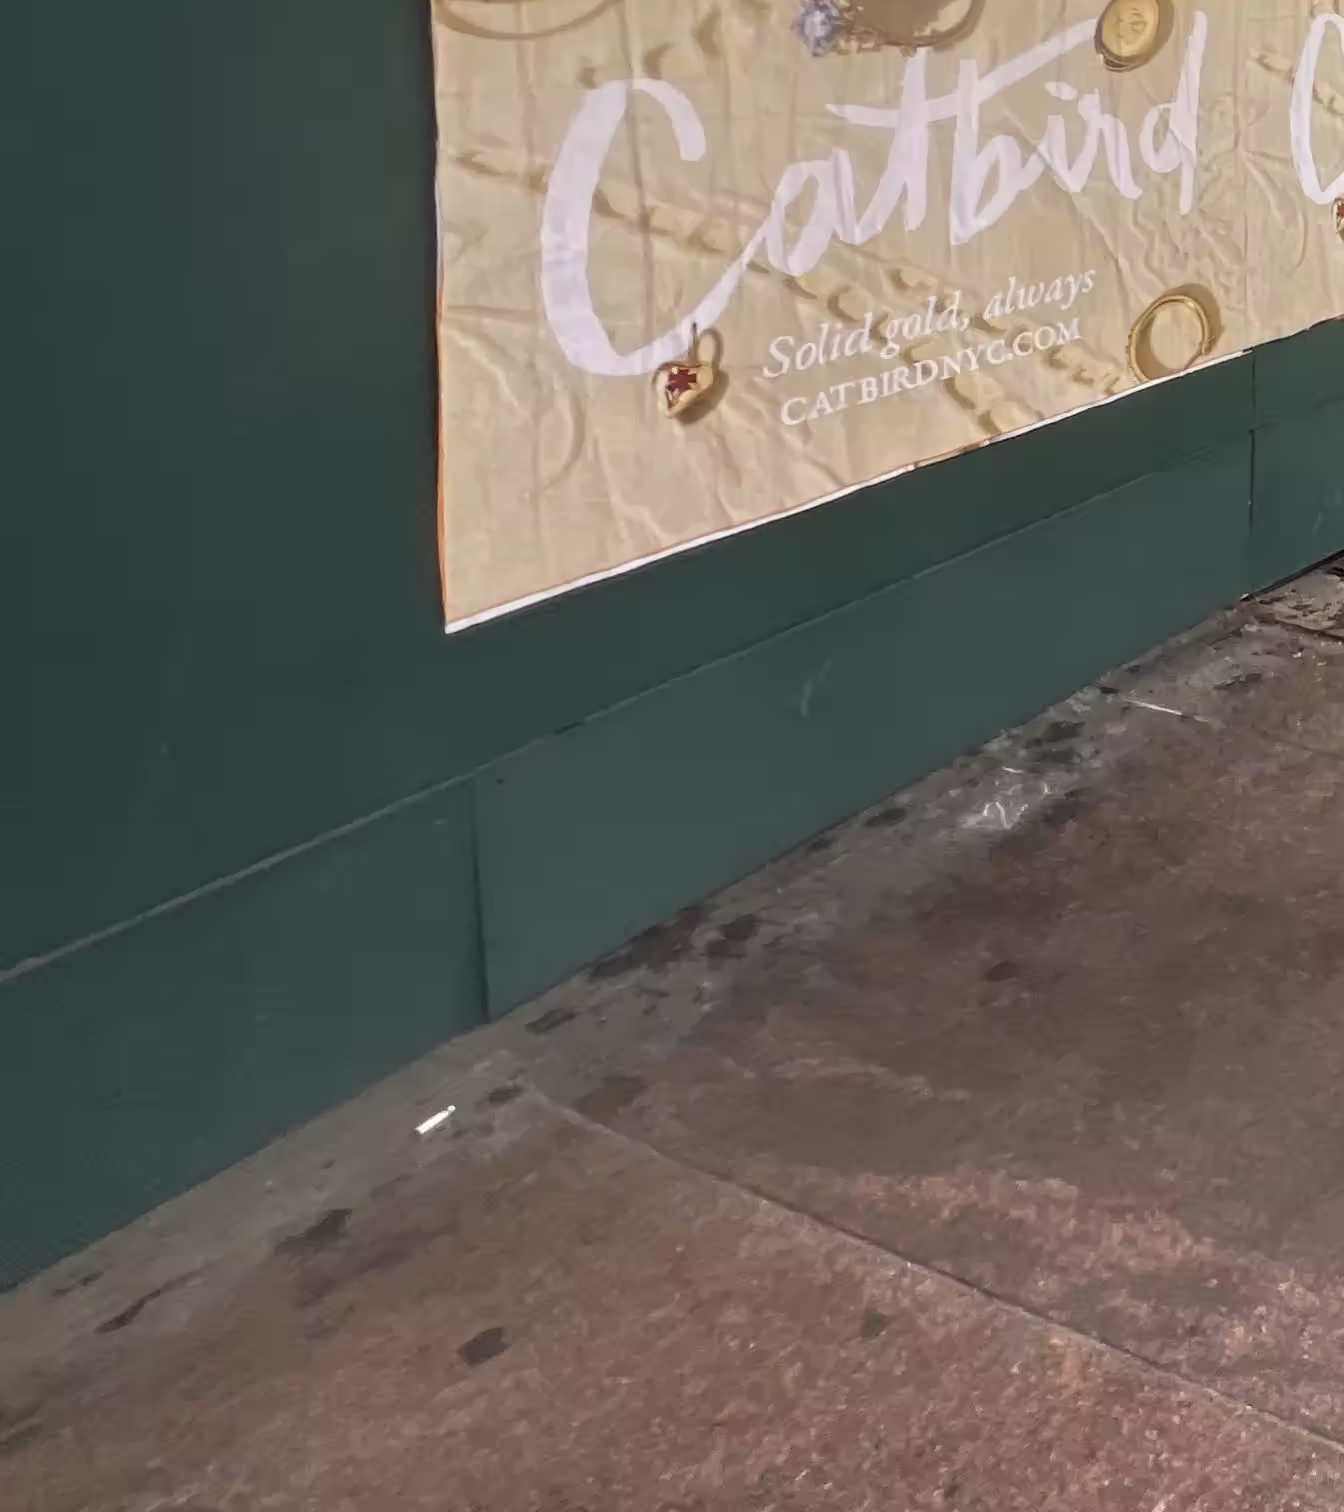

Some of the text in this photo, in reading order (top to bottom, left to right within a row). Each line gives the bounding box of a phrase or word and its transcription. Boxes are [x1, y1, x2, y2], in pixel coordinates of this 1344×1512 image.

[541, 11, 1208, 377] Catbird
[761, 265, 1097, 382] Solid gold, always
[779, 316, 1083, 428] CATBIRDNYC.COM
